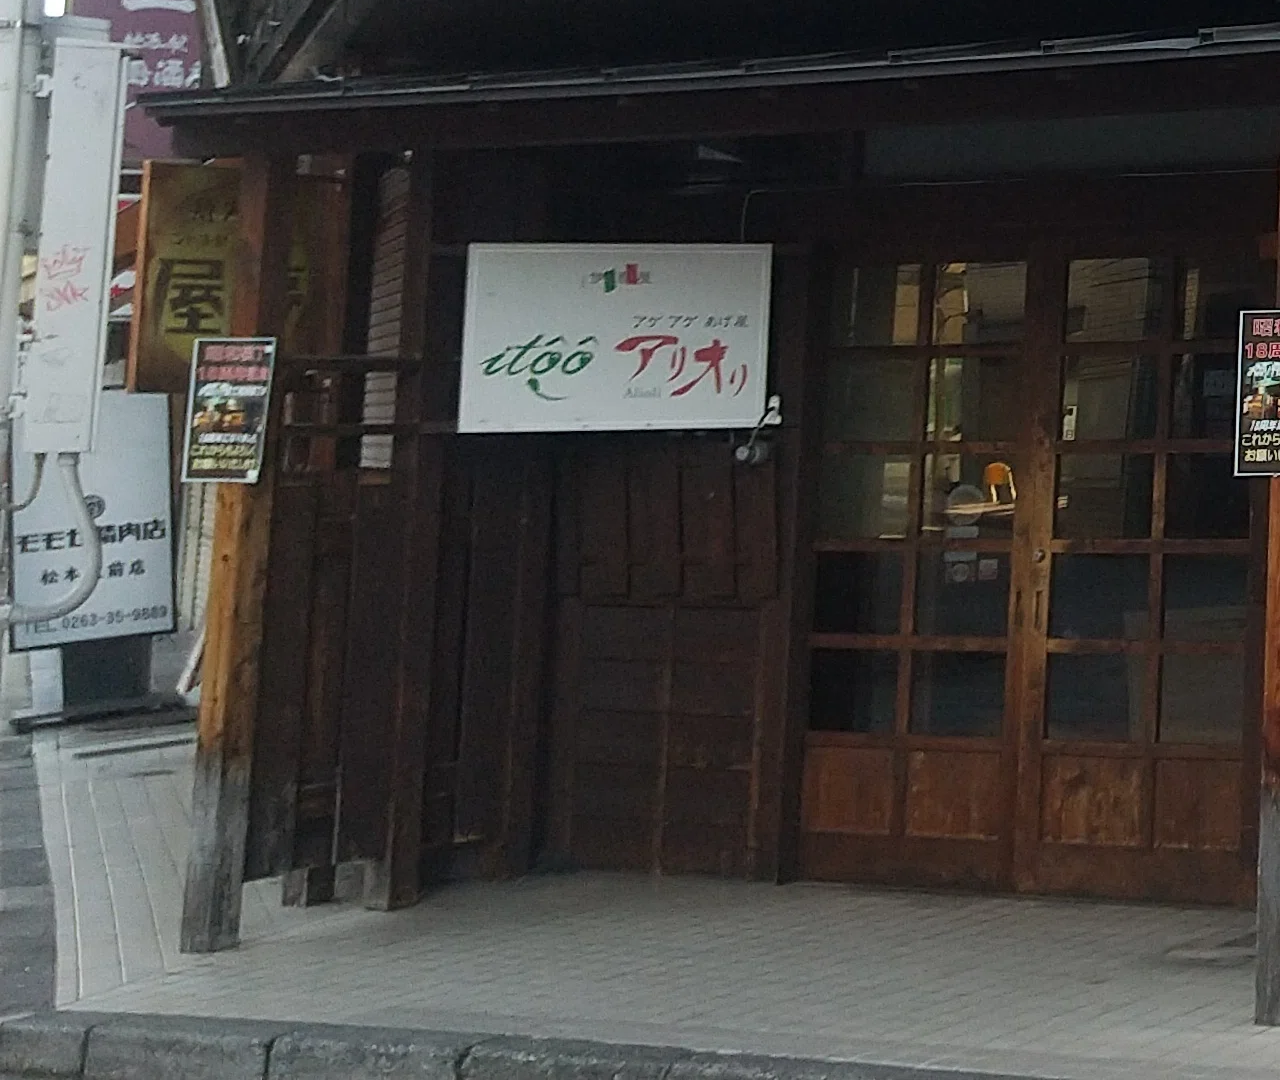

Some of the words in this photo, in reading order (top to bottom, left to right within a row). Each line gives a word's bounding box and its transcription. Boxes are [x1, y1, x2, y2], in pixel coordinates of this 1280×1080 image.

[152, 257, 226, 334] 屋
[614, 335, 747, 397] アリオリ
[40, 558, 146, 586] 松本前店
